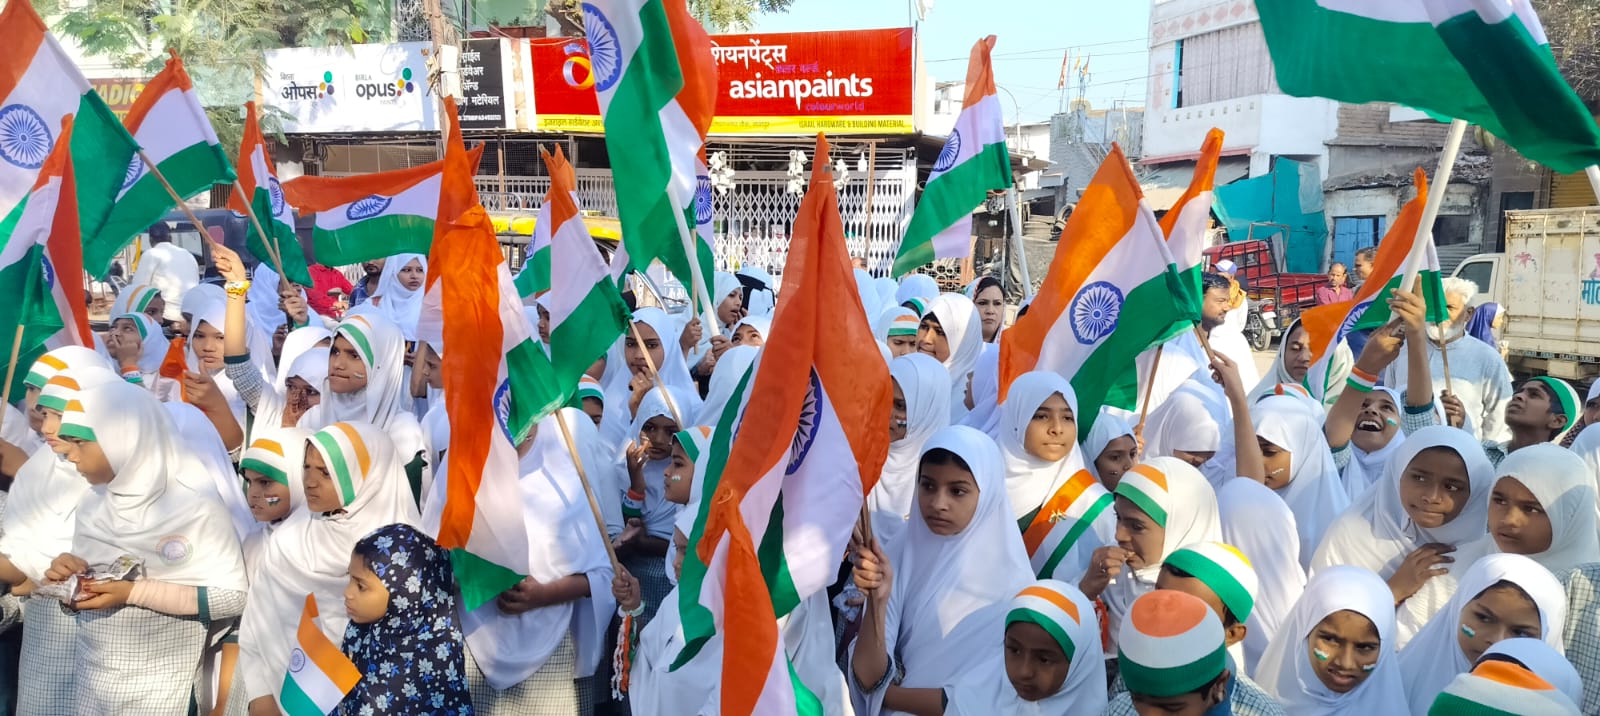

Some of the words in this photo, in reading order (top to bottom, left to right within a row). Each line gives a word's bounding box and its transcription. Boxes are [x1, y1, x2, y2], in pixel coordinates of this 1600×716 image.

[281, 81, 318, 100] ओपस
[356, 83, 396, 100] opus
[729, 70, 873, 110] asianpaints
[805, 101, 865, 112] colourworld
[816, 120, 846, 128] HARDWARE
[852, 120, 877, 128] BUILDING
[878, 120, 904, 128] MATERIAL
